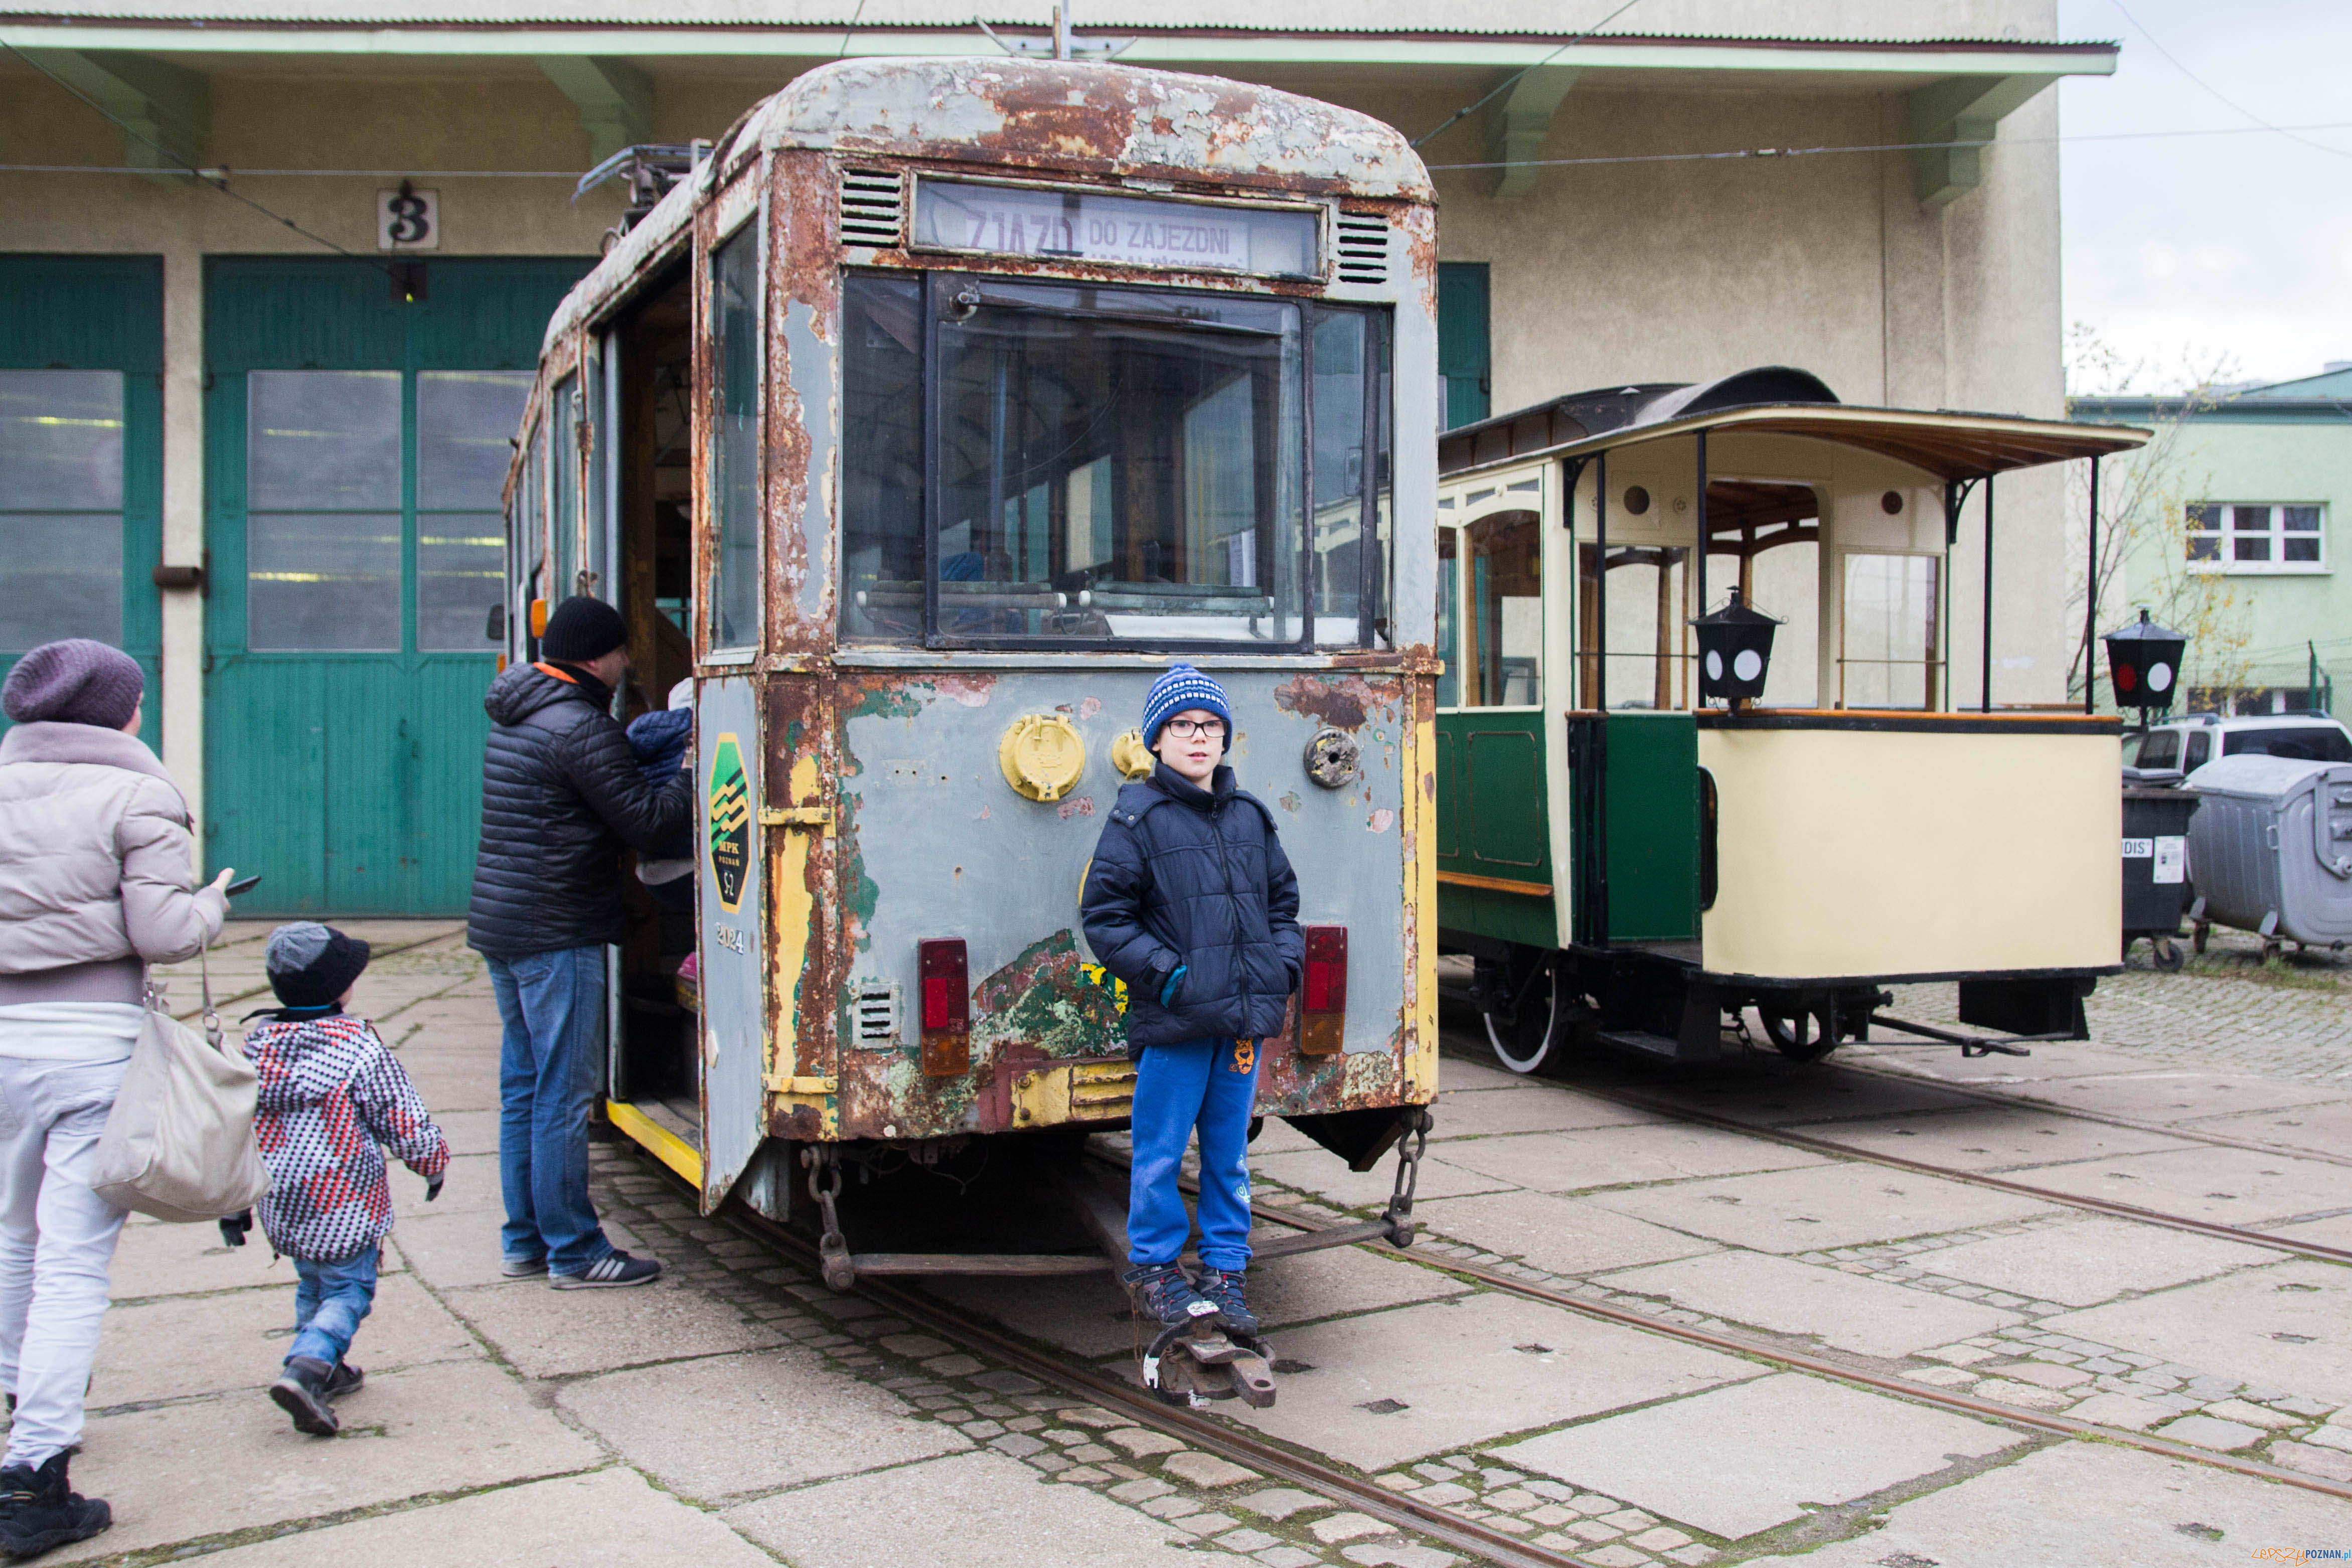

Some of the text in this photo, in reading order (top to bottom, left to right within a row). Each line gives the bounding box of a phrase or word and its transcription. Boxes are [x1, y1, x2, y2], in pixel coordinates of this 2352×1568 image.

[388, 196, 428, 242] 3
[965, 211, 1073, 254] ZJAZD
[1089, 219, 1229, 254] DO ZAJEZDNI
[718, 841, 739, 854] MPK
[2121, 841, 2144, 854] DIS
[716, 922, 743, 955] 2024
